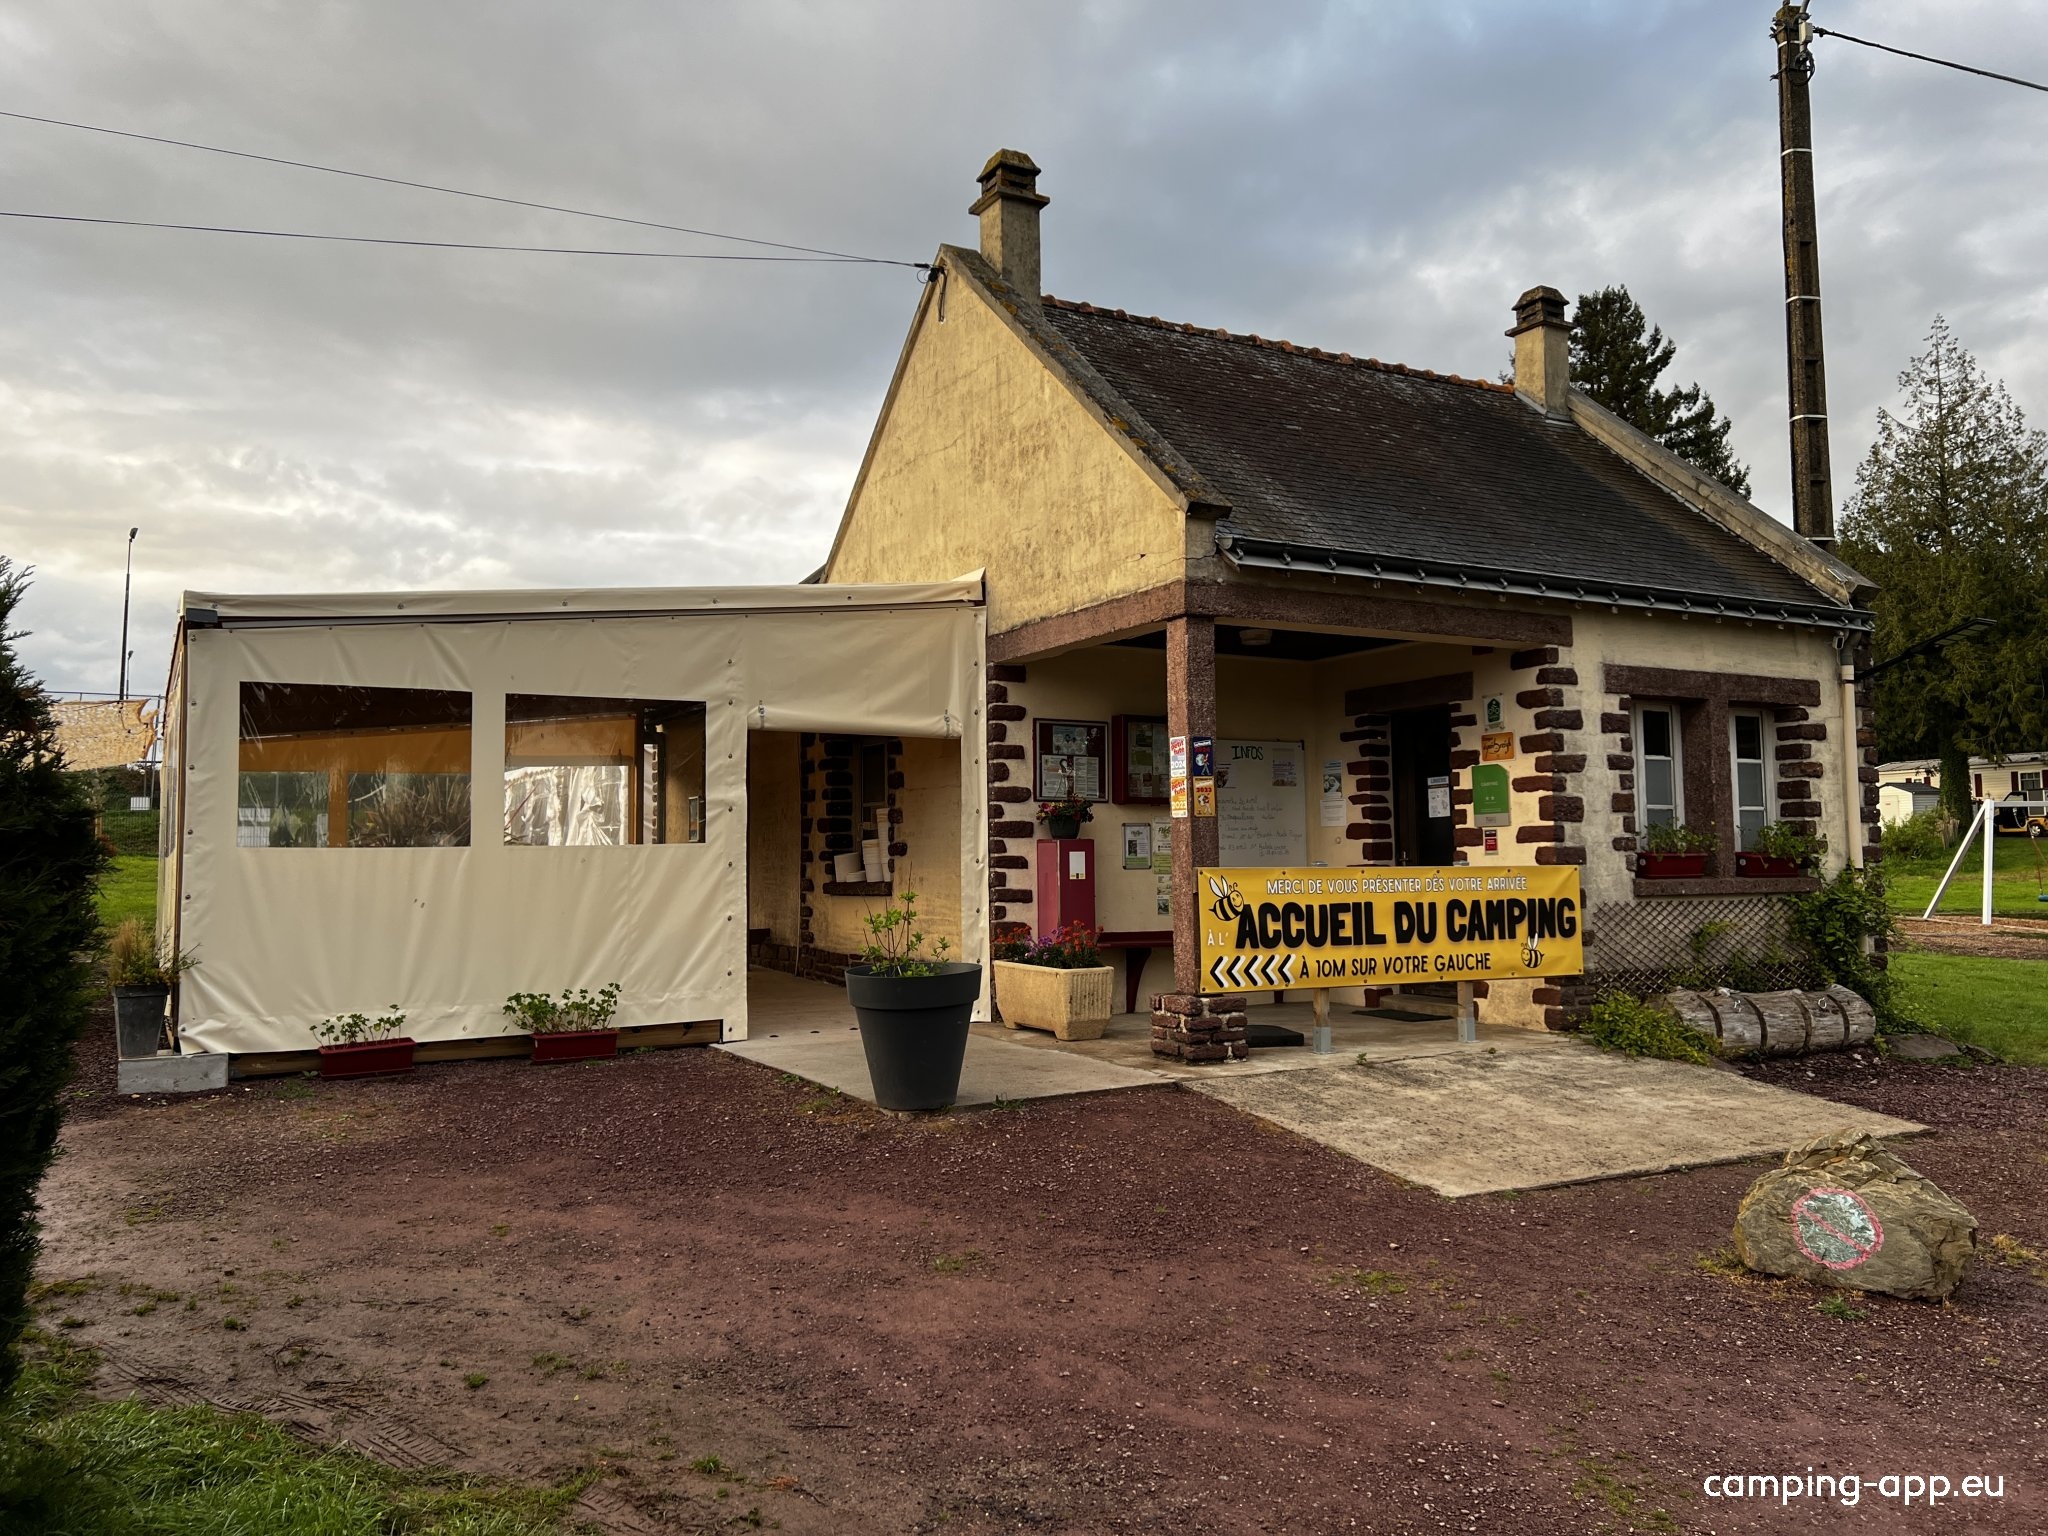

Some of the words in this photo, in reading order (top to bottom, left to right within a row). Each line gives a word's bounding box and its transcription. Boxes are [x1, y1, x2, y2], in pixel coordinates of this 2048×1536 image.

[1231, 746, 1263, 760] INFOS
[1172, 801, 1186, 809] 2023
[1267, 879, 1304, 895] MERCI
[1308, 879, 1322, 894] DE
[1327, 878, 1358, 894] VOUS
[1362, 875, 1421, 893] PRÉSENTER
[1425, 874, 1445, 892] DÈS
[1450, 877, 1483, 891] VOTRE
[1487, 873, 1527, 891] ARRIVÉE
[1207, 929, 1215, 946] À
[1235, 901, 1387, 949] ACCUEIL
[1394, 900, 1437, 944] DU
[1446, 897, 1577, 942] CAMPING
[1300, 956, 1309, 979] À
[1316, 958, 1346, 978] 10M
[1351, 957, 1378, 976] SUR
[1383, 955, 1428, 974] VOTRE
[1434, 952, 1491, 973] GAUCHE
